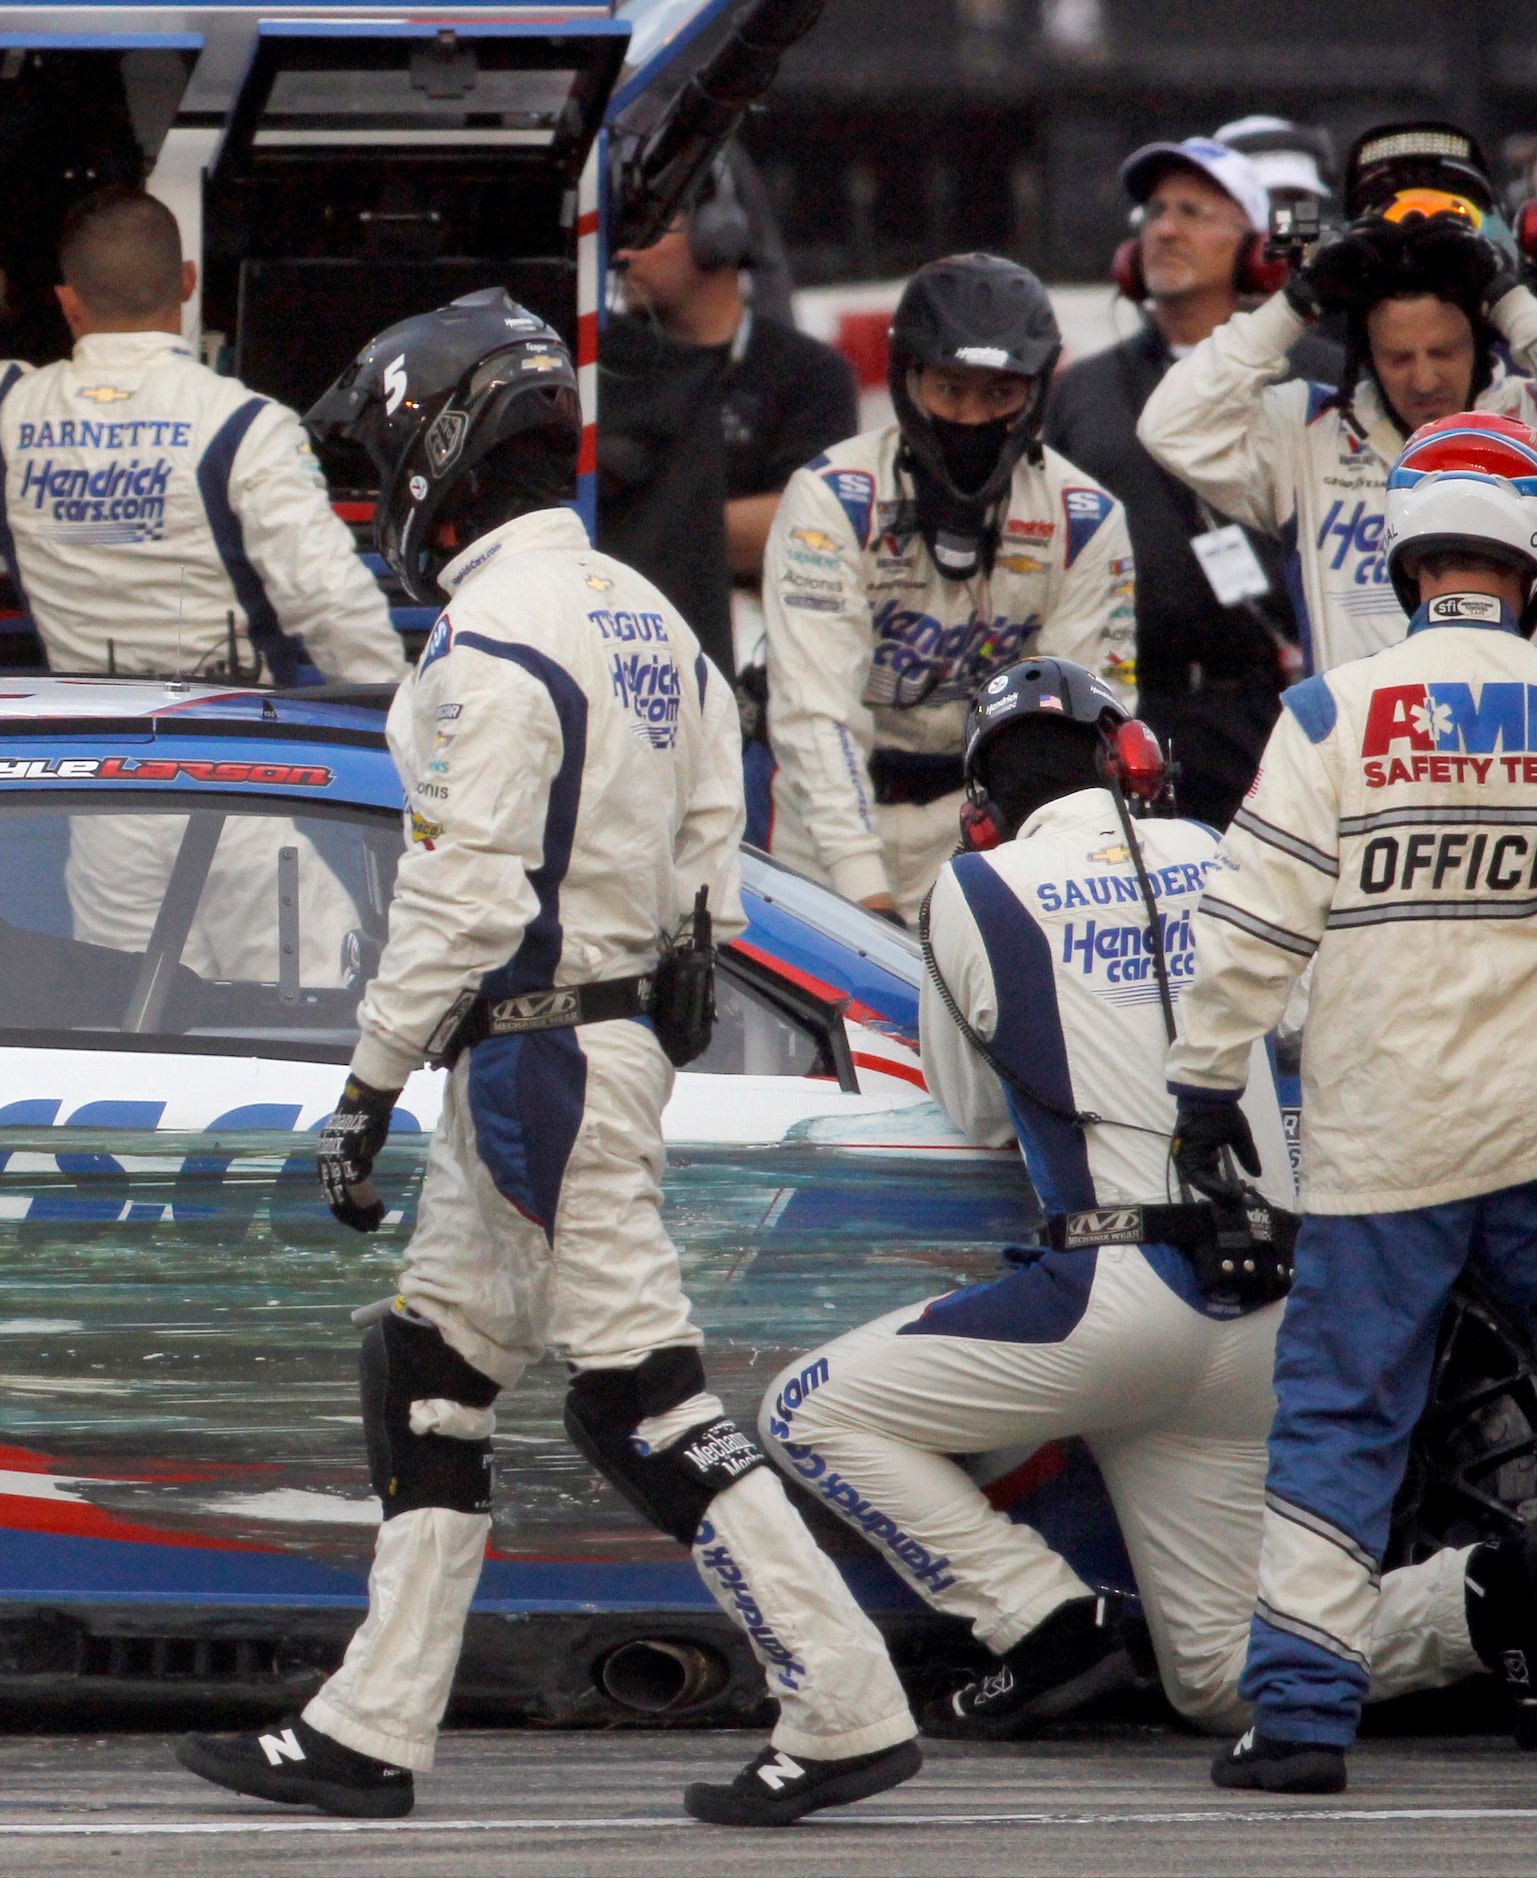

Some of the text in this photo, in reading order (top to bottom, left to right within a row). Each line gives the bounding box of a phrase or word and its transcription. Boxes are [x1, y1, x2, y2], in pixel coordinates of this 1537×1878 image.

[384, 353, 408, 418] 5
[16, 419, 192, 450] BARNETTE
[19, 457, 174, 510] Hendrick
[51, 496, 166, 522] cars.com
[1363, 755, 1495, 788] SAFETY
[1067, 1230, 1141, 1245] MECHANIX WEAR
[257, 1727, 307, 1767] N
[1233, 1726, 1258, 1756] N
[757, 1749, 806, 1791] N
